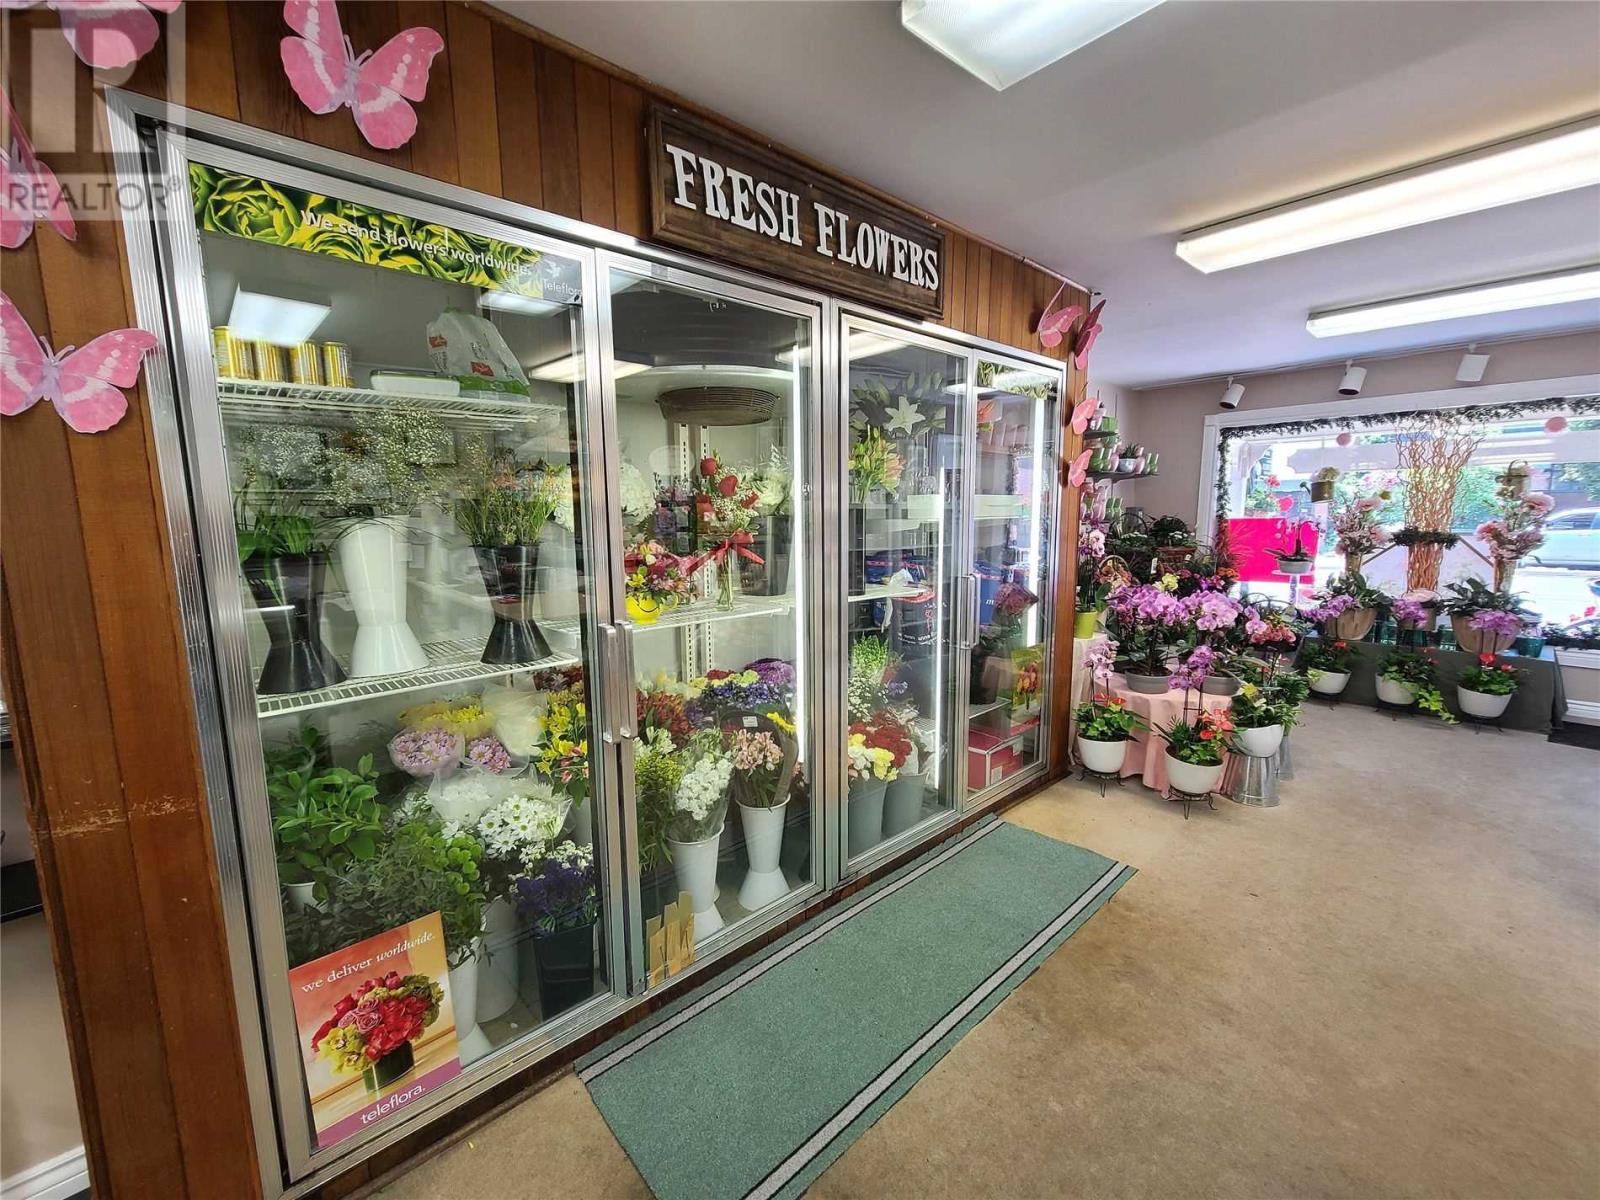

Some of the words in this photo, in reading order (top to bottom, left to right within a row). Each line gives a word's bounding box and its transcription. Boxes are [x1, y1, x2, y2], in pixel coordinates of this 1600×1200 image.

[301, 210, 334, 230] We
[340, 220, 381, 242] send
[387, 231, 449, 256] flowers
[666, 143, 803, 247] FRESH
[813, 201, 940, 291] FLOWERS
[302, 980, 324, 993] we
[327, 958, 373, 983] deliver
